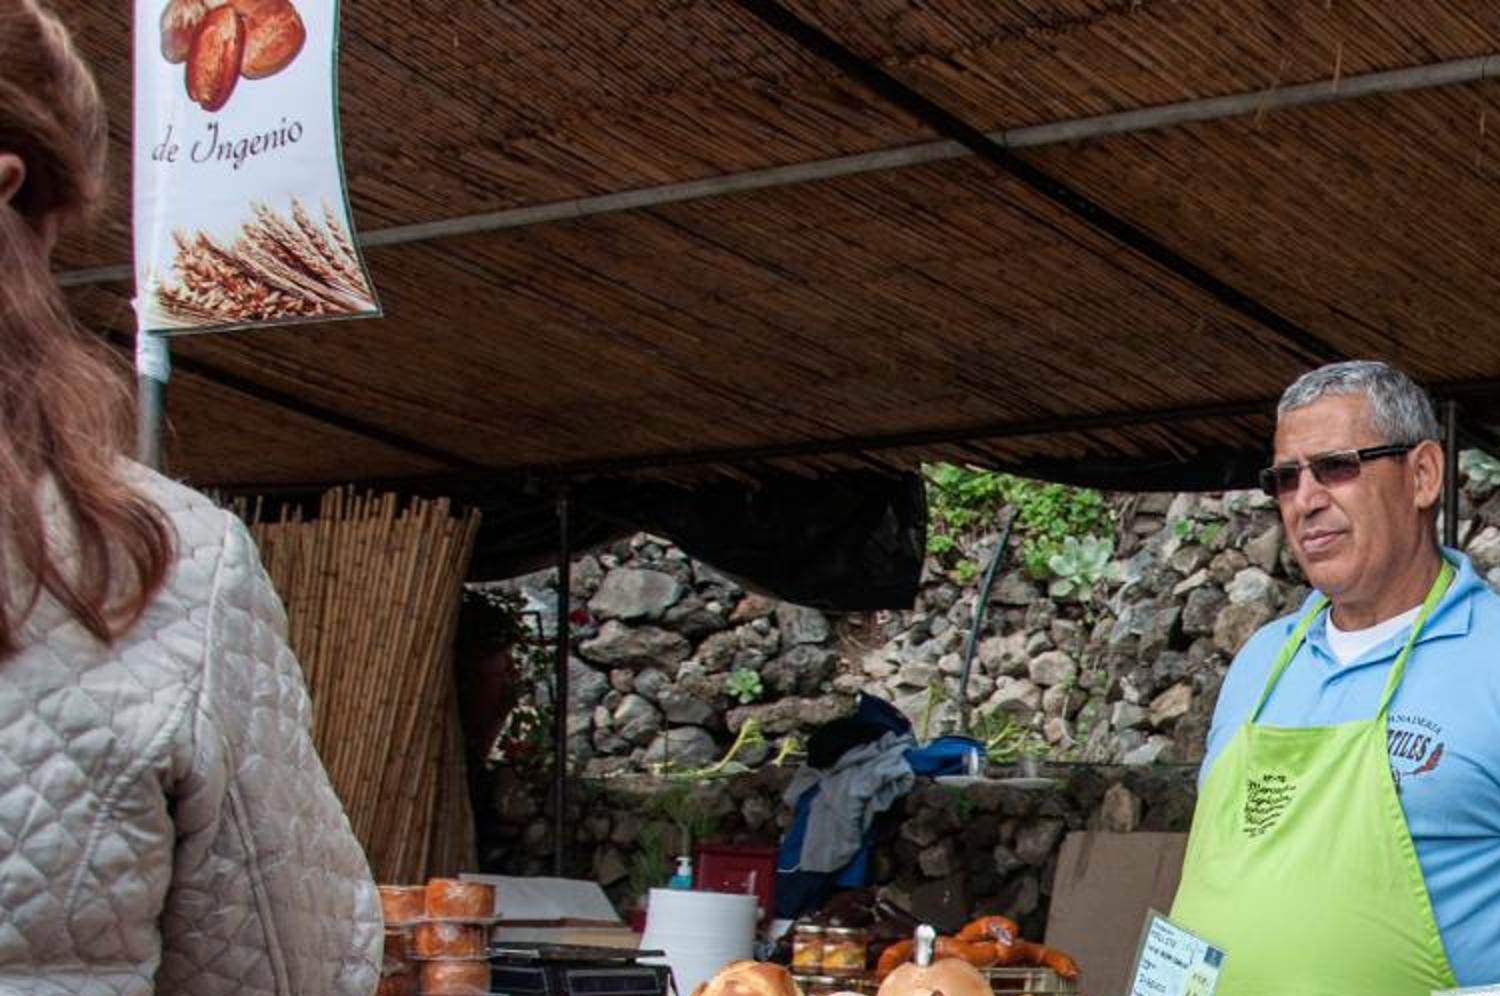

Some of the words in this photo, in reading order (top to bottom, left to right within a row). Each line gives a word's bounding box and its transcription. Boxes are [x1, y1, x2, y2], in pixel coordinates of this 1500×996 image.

[152, 124, 179, 162] de
[190, 117, 304, 170] Ingenio
[1388, 714, 1442, 735] ANADERIA
[1388, 729, 1432, 762] TILES
